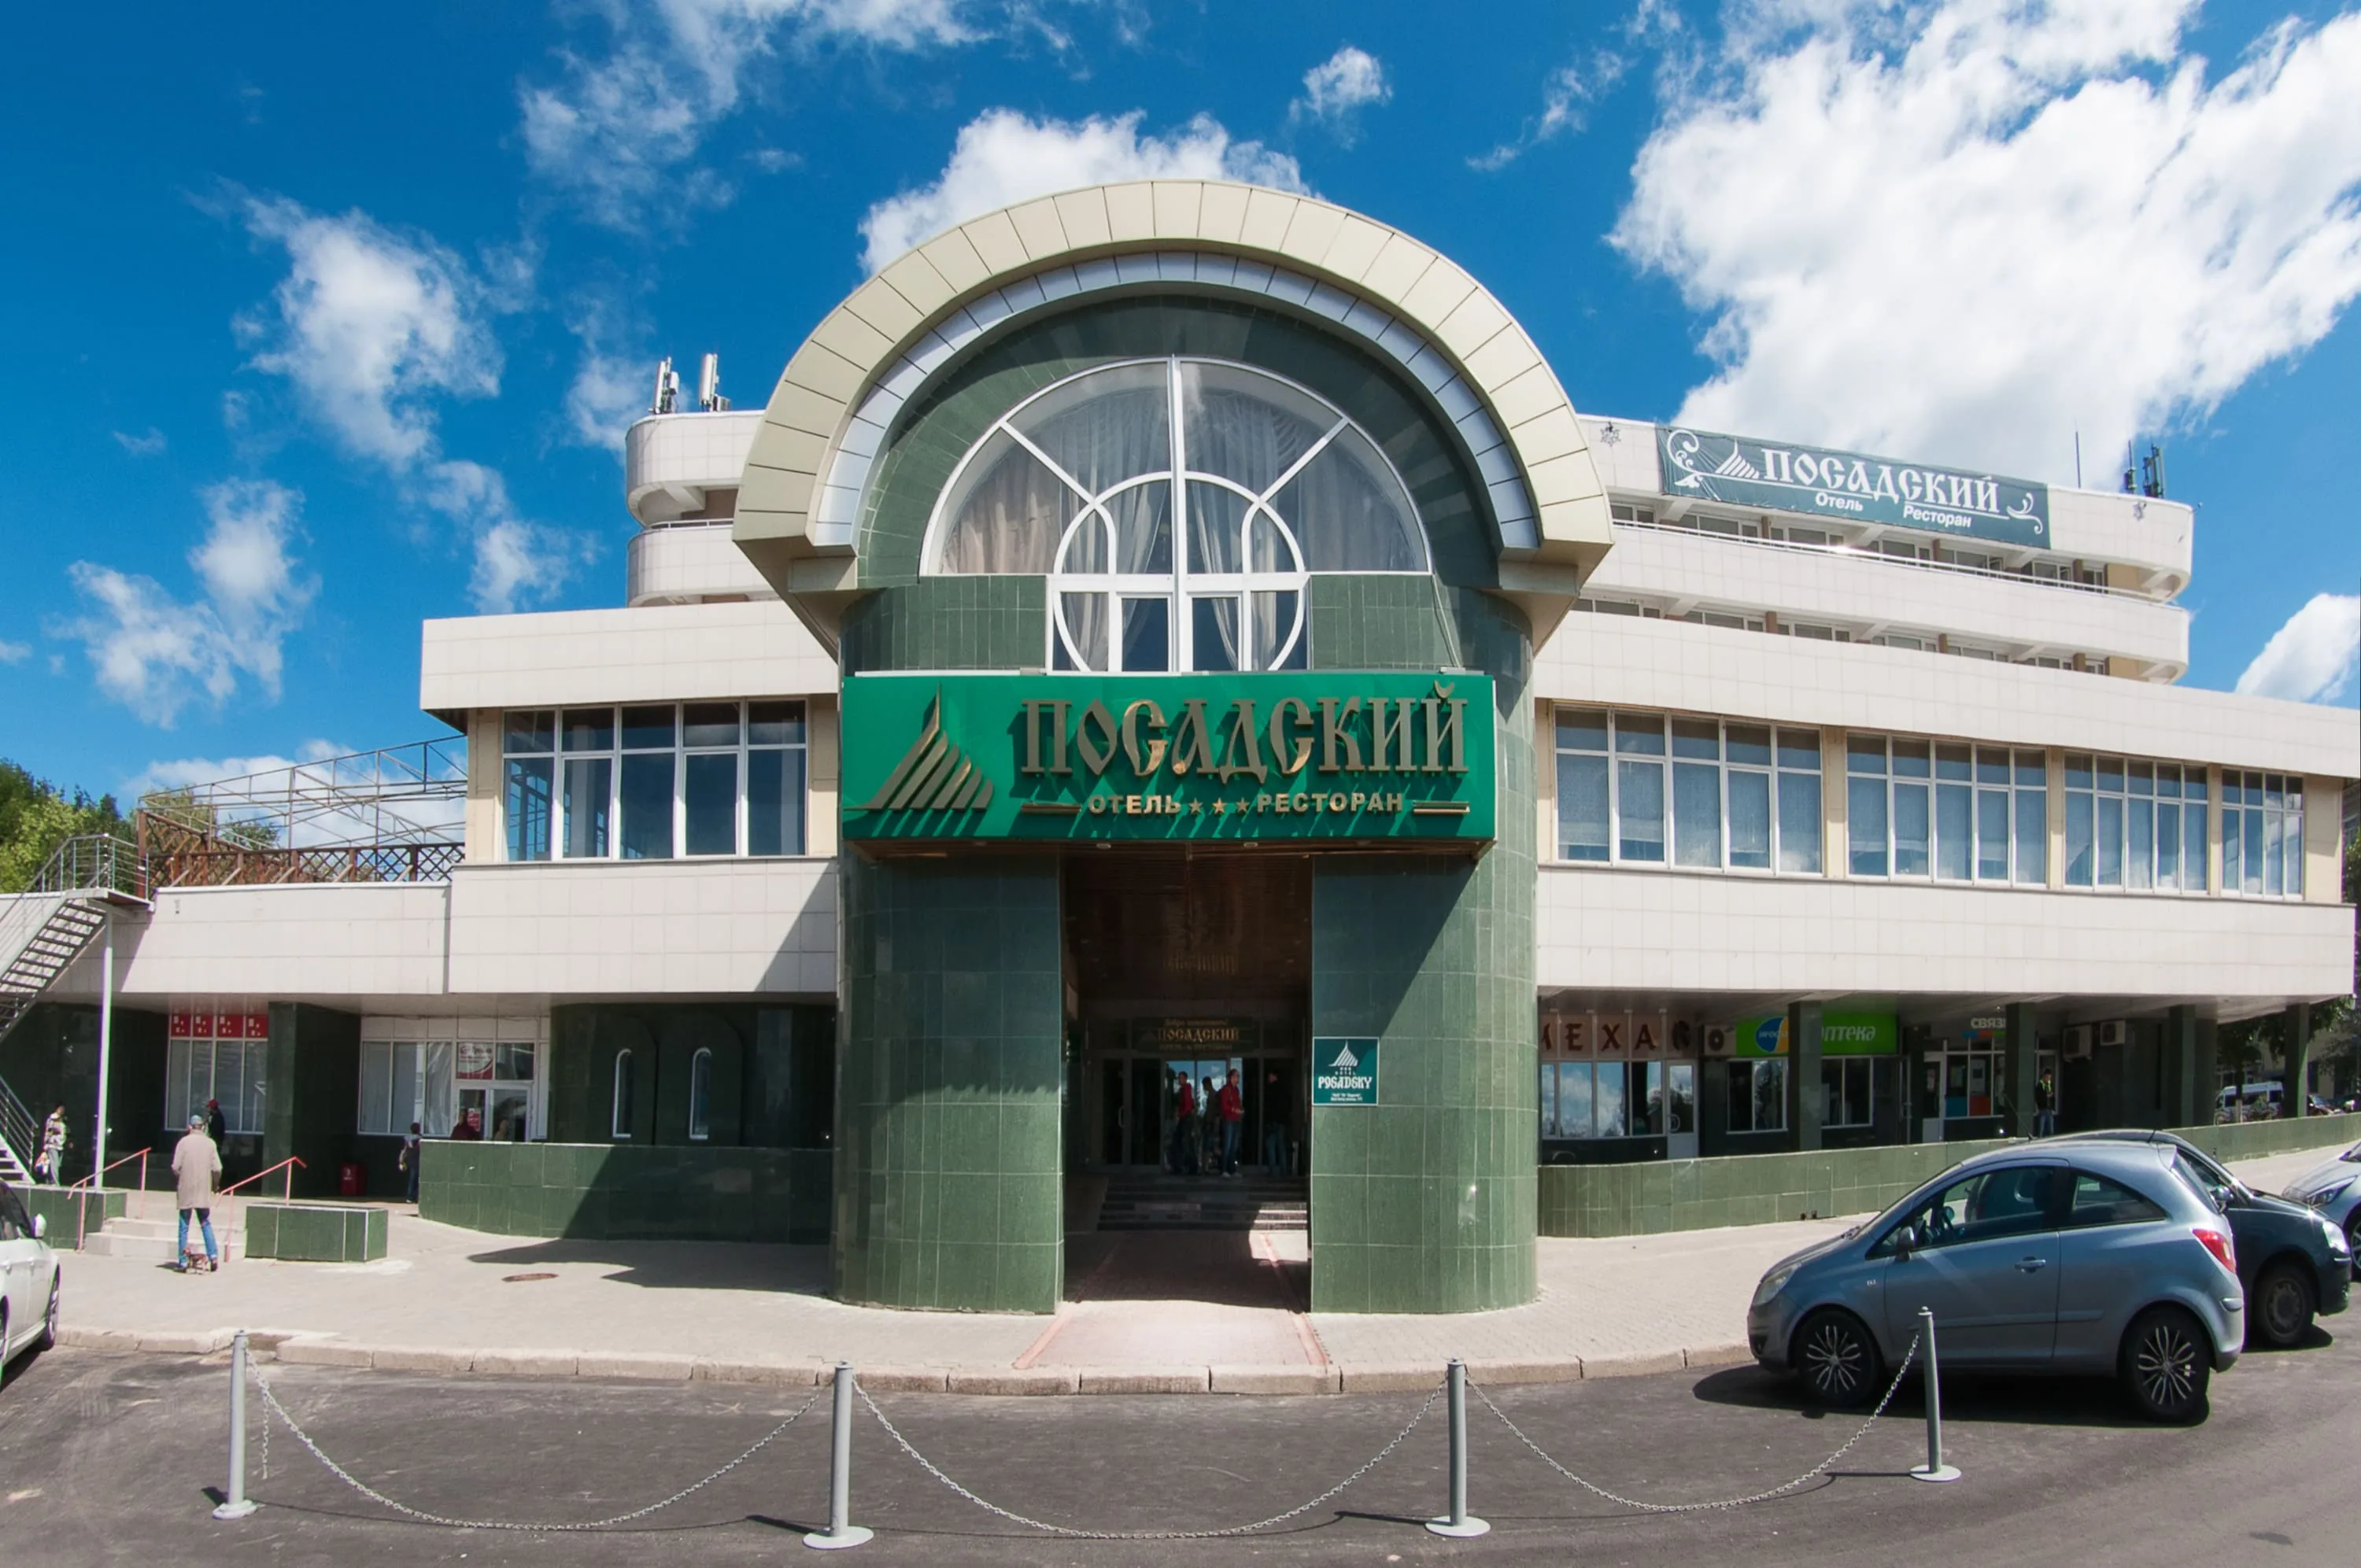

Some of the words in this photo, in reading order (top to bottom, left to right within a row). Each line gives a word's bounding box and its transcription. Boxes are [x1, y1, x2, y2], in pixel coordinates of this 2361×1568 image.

[1761, 448, 2000, 513] ПОСАДСКИЙ
[1815, 492, 1864, 511] Отель
[1903, 504, 1971, 528] Ресторан
[1021, 679, 1469, 784] ПОСАДСКИЙ
[1088, 794, 1181, 814] ОТЕЛЬ
[1257, 791, 1403, 814] РЕСТОРАН
[1821, 1025, 1875, 1042] птека
[1317, 1075, 1373, 1090] POSADSKY
